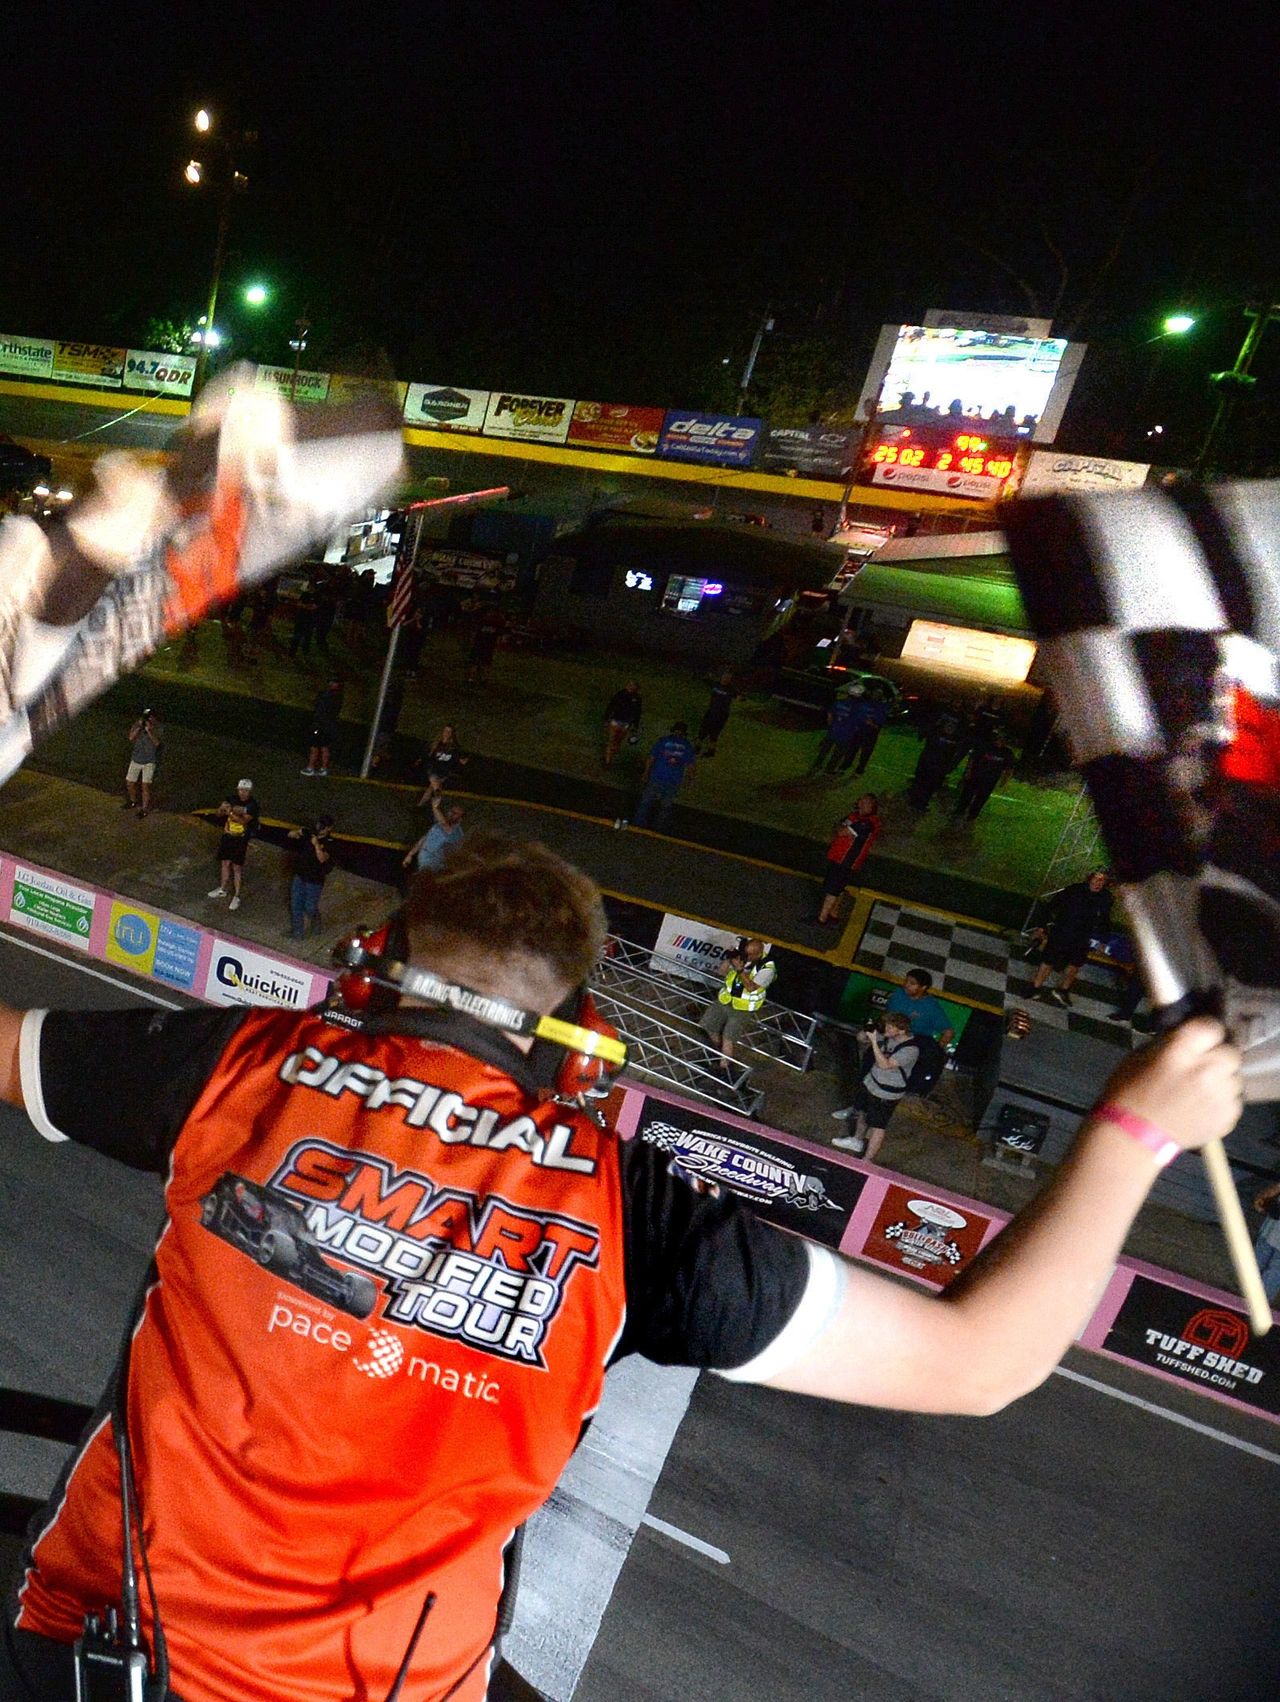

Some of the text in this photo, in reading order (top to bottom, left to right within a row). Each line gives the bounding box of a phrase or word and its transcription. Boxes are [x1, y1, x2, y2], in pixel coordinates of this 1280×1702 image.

[127, 358, 192, 385] 94.7 QDR
[494, 395, 566, 416] FOREVER
[669, 419, 756, 440] delta
[873, 445, 898, 463] 25
[937, 453, 953, 470] 2
[216, 955, 299, 1004] Quickill
[412, 974, 527, 1031] RACING ELECTRONICS
[278, 1046, 597, 1177] OFFICIAL
[674, 1152, 789, 1198] Speedway
[676, 1131, 807, 1194] WAKE COUNTY
[280, 1146, 599, 1280] SMART
[307, 1205, 558, 1316] MODIFIED
[399, 1281, 545, 1361] TOUR
[267, 1304, 501, 1403] pace matic
[1145, 1328, 1265, 1385] TUFF SHED
[1154, 1353, 1237, 1389] TUFFSHED.COM
